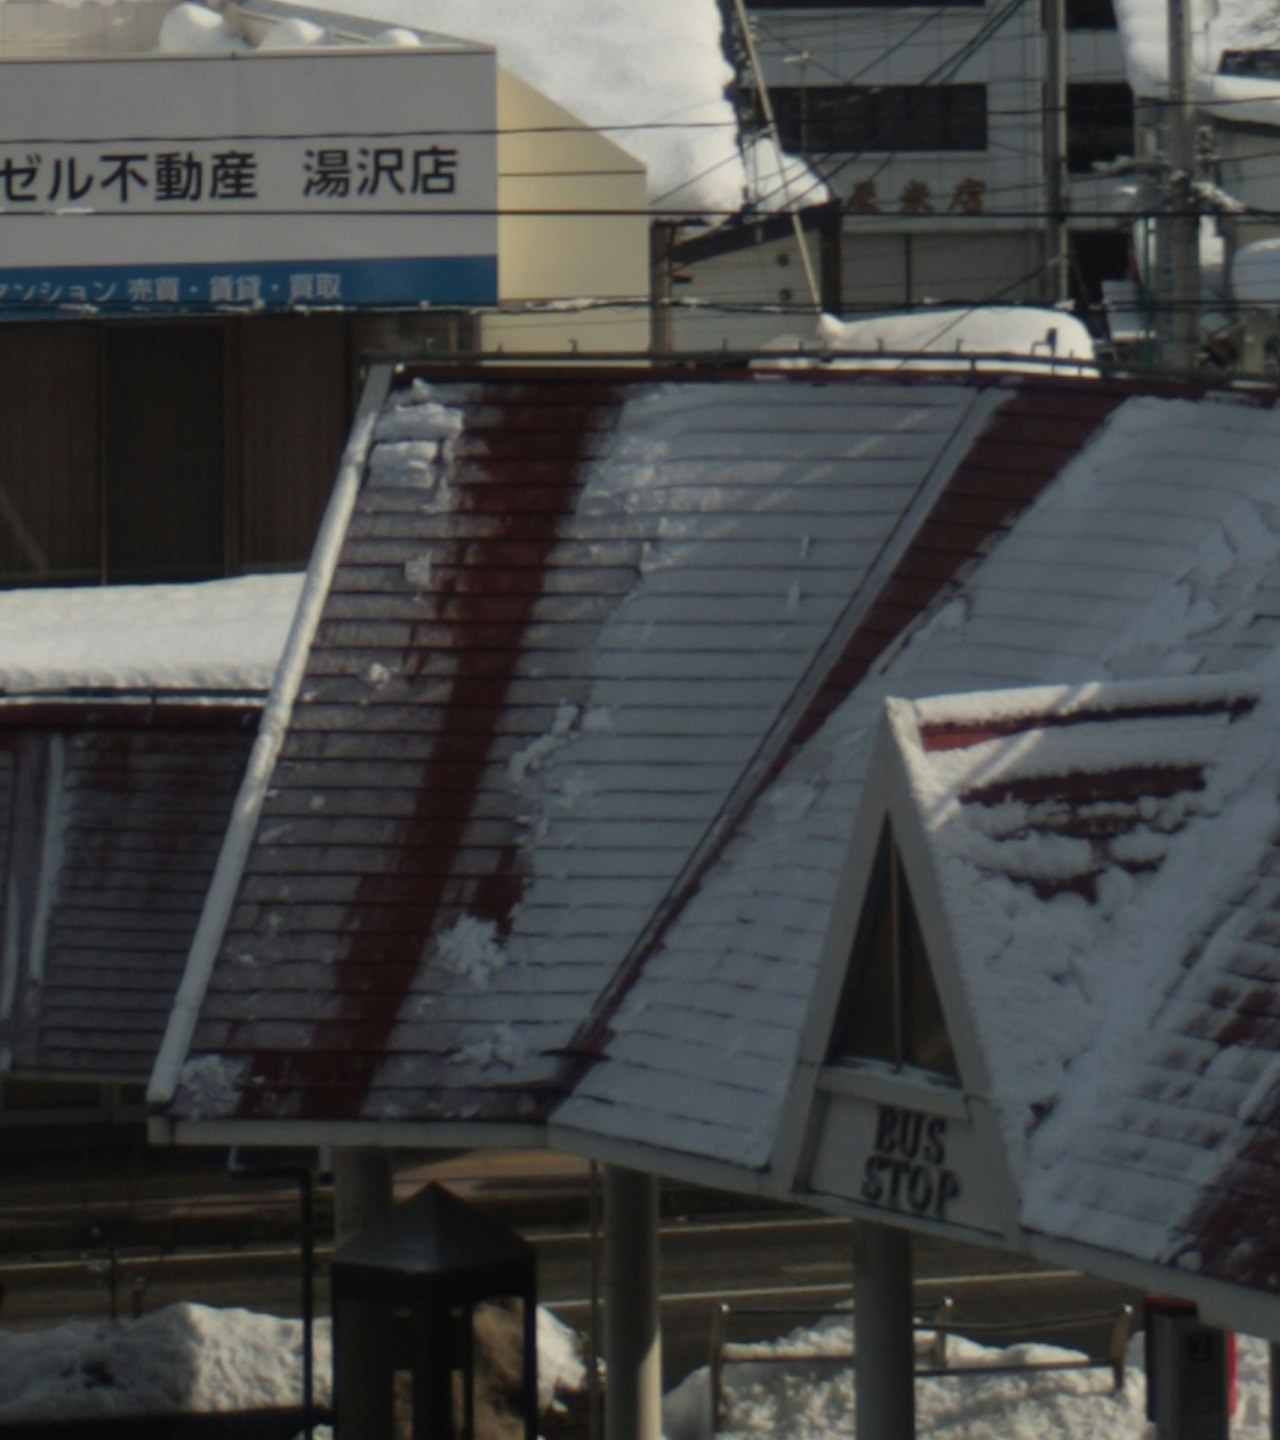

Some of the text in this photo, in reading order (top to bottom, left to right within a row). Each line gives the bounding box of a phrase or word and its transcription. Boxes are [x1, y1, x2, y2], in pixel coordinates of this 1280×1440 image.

[301, 146, 459, 198] 湯沢店
[875, 1104, 947, 1165] BUS
[860, 1154, 961, 1221] STOP
